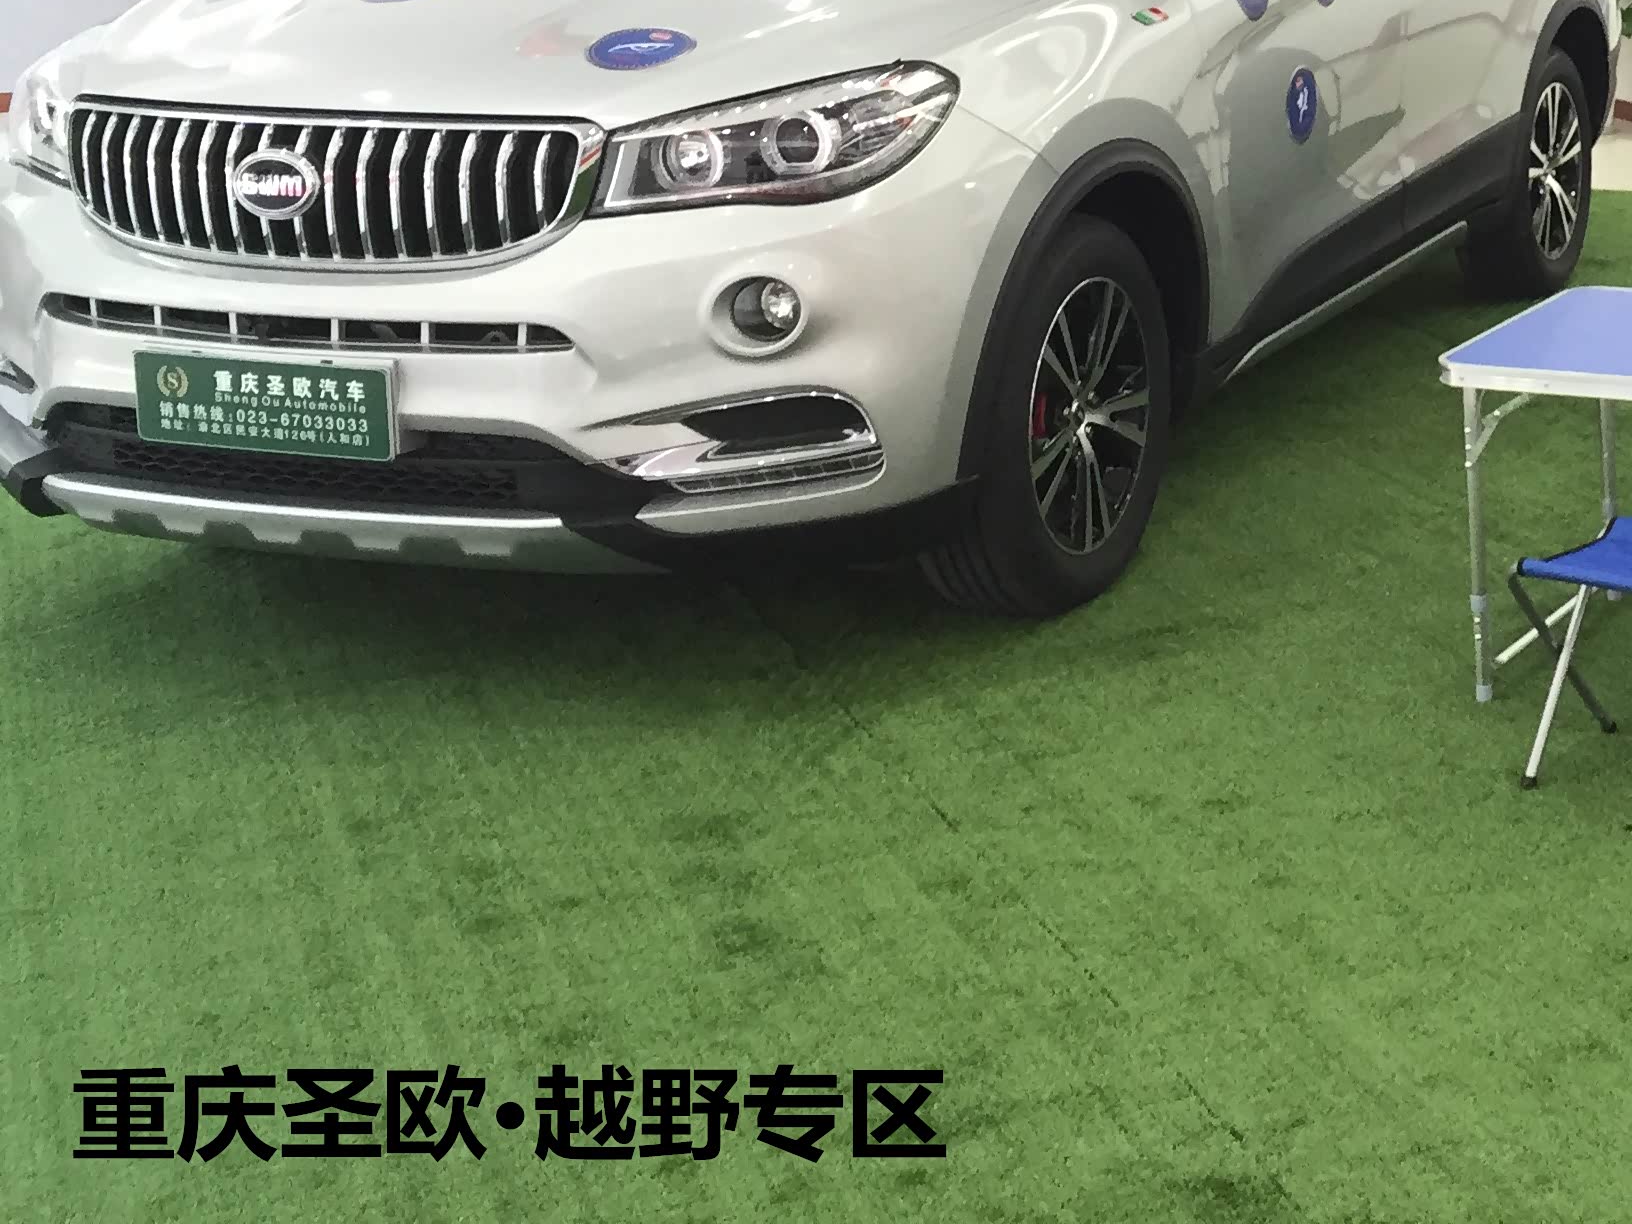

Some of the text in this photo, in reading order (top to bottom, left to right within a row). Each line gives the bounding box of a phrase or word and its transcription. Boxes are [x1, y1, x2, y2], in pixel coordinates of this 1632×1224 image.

[213, 370, 365, 402] 重庆圣欧汽车
[261, 395, 280, 407] Ou
[284, 397, 366, 414] Automobile
